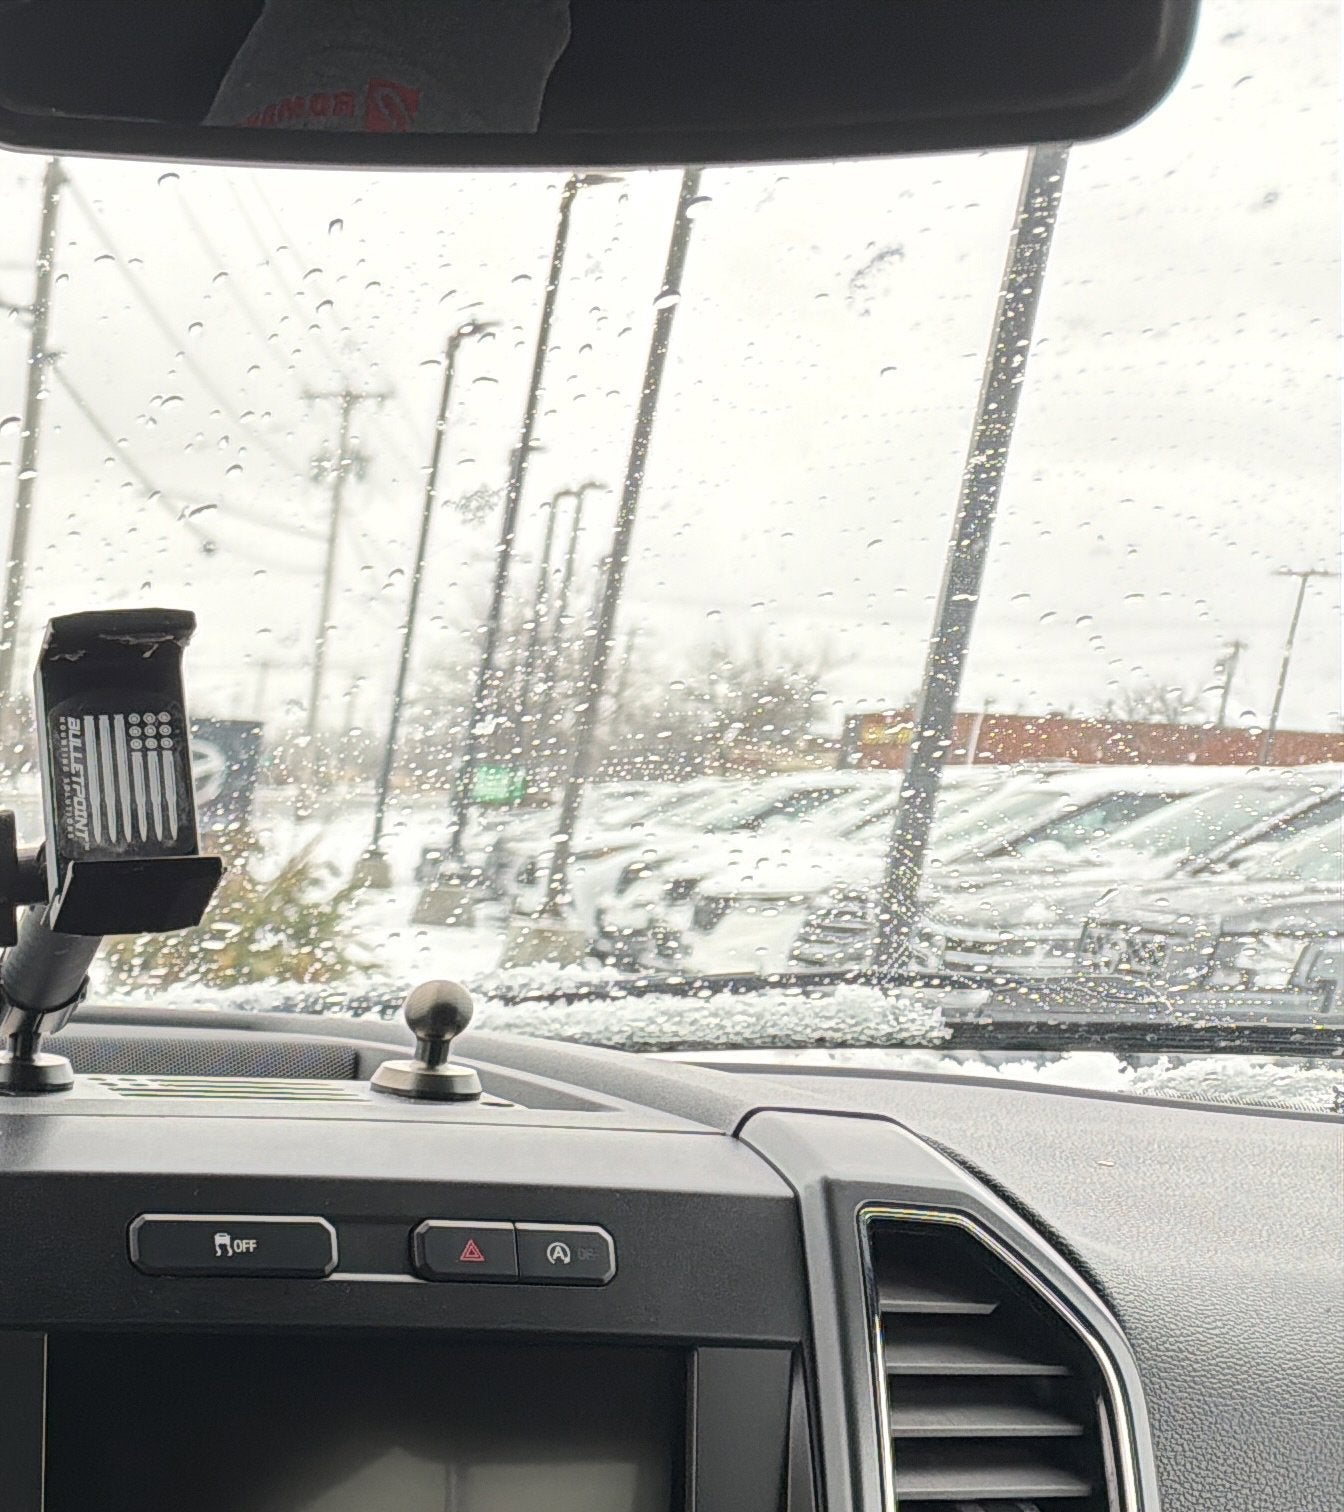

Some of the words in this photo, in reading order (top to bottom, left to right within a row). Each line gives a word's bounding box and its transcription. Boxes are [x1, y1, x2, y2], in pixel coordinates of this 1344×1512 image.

[59, 716, 70, 773] MOUNTING
[62, 776, 75, 840] SOLUTIONS
[67, 716, 90, 843] BULLETPOINT
[233, 1238, 258, 1254] OFF
